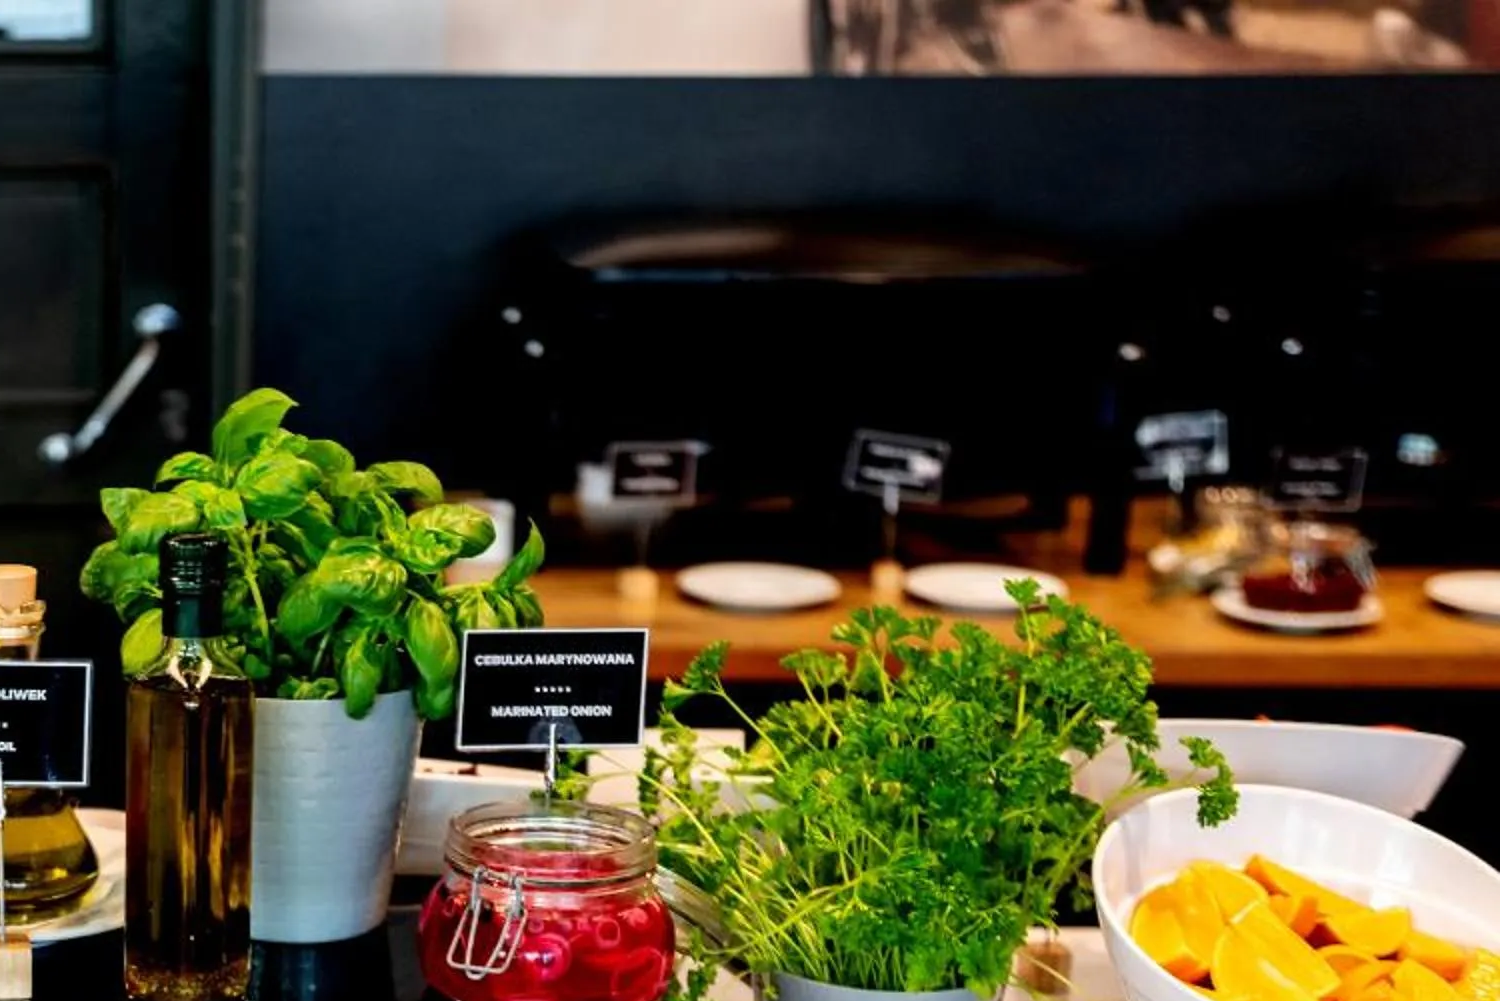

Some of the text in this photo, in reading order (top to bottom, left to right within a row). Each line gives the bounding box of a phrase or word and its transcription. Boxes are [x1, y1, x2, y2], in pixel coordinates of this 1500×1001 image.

[474, 653, 635, 667] CEBULKA MARYNOWANA
[491, 705, 613, 718] MARINATED ONION
